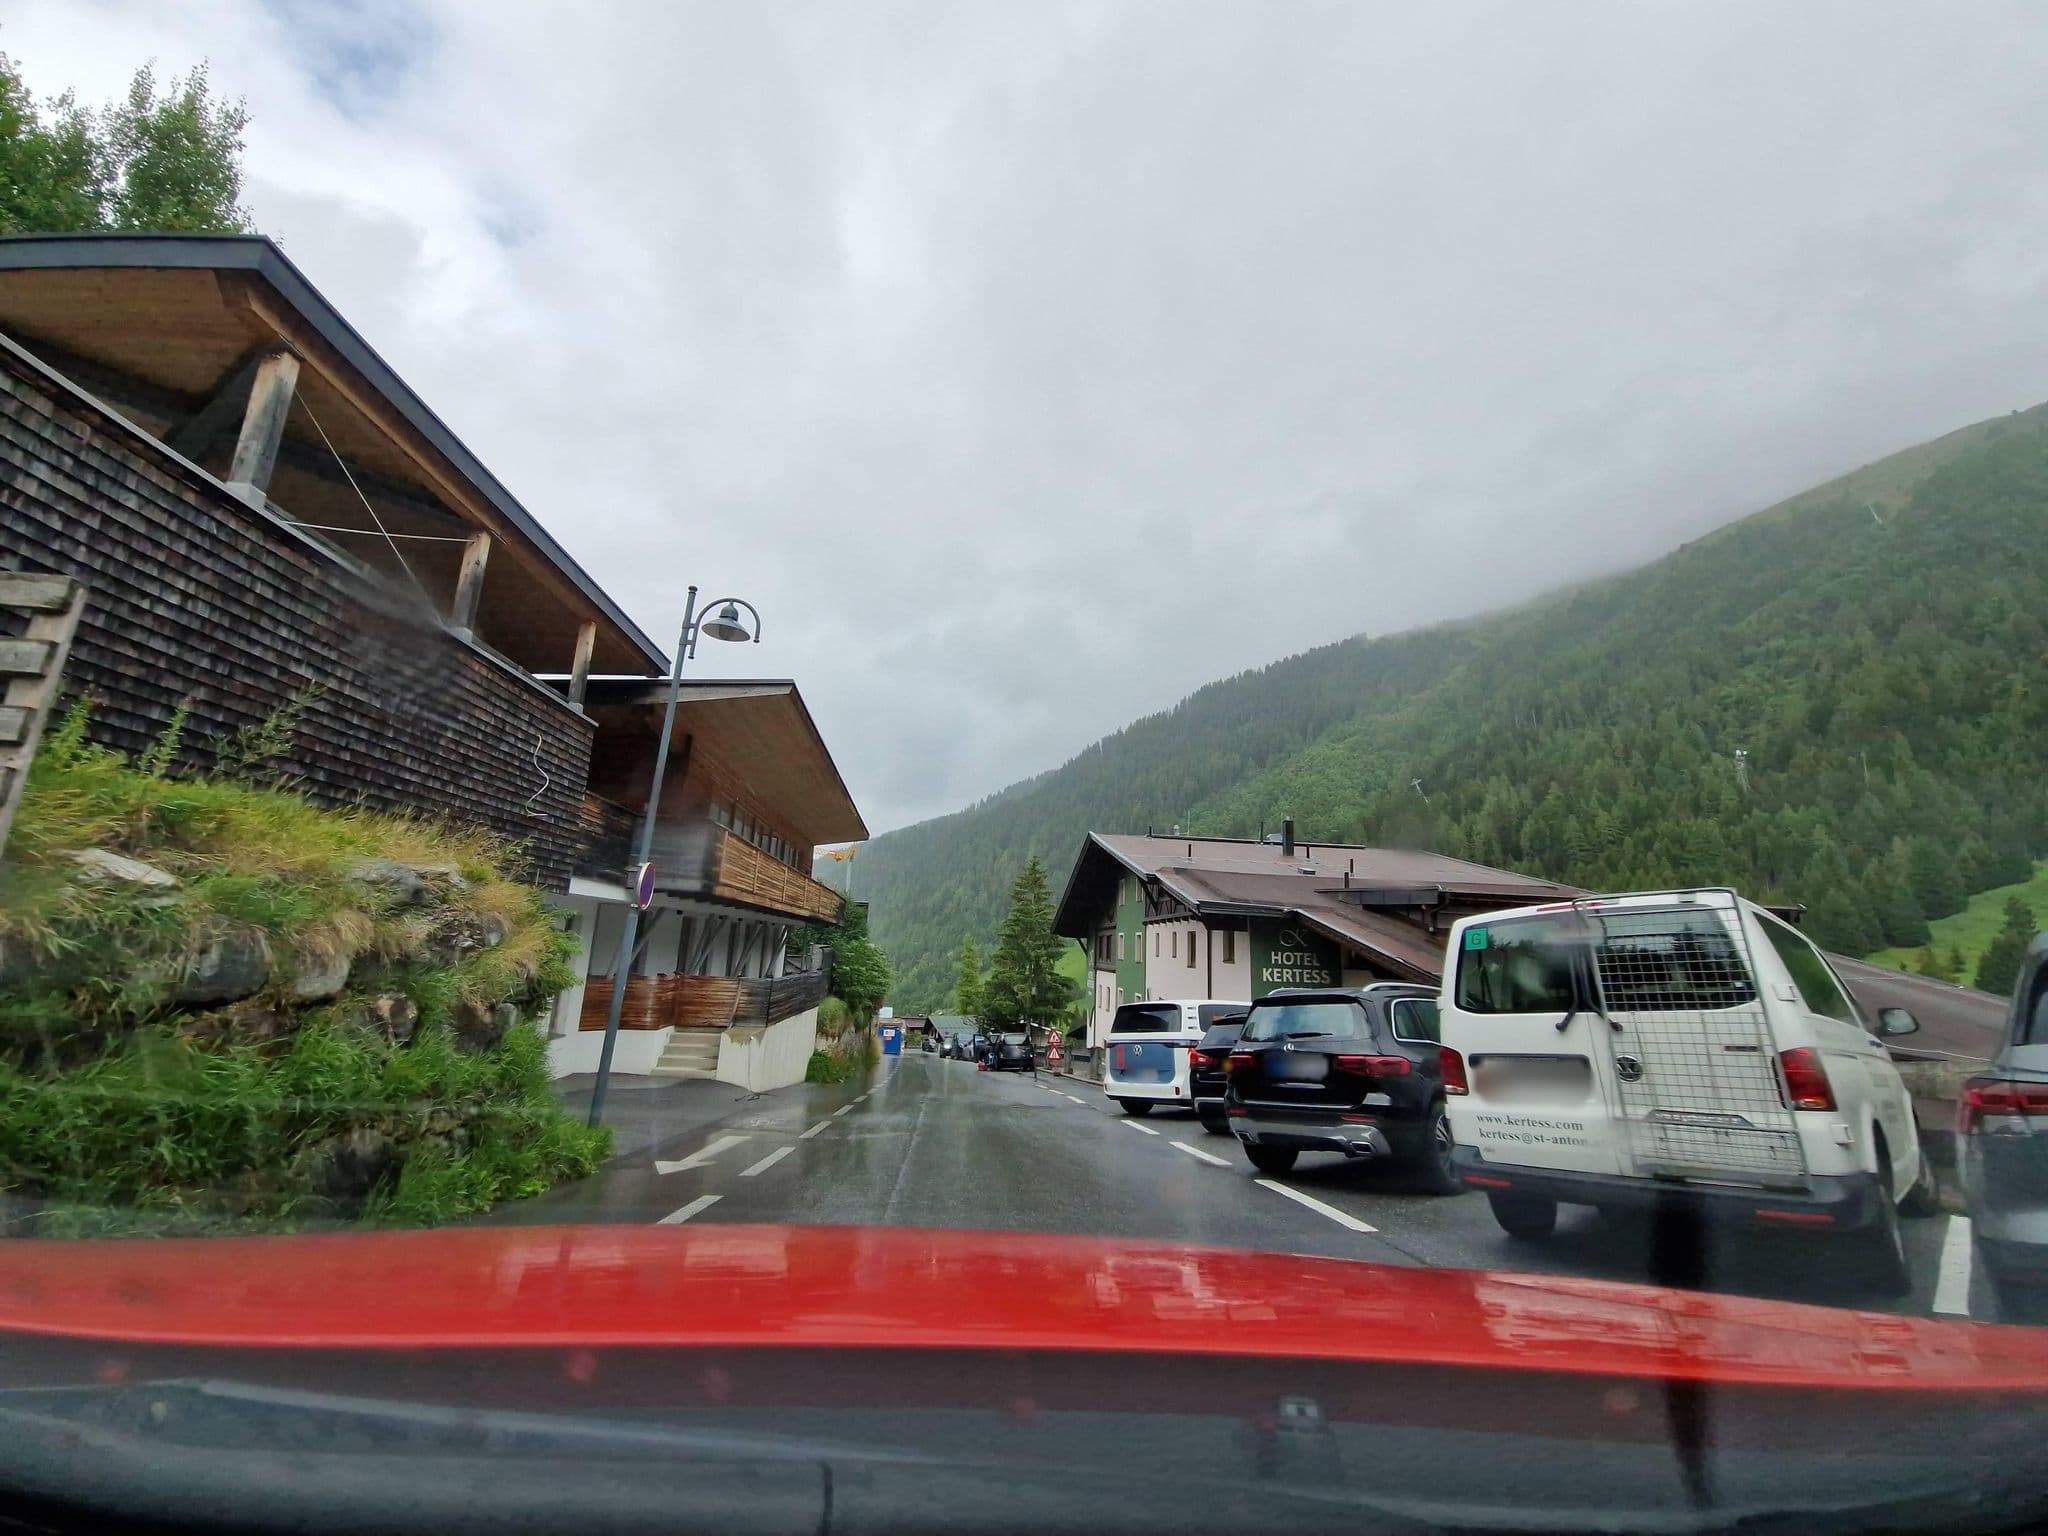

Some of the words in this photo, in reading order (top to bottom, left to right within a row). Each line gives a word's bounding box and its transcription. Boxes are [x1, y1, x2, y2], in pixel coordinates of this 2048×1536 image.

[1472, 933, 1481, 945] G
[1271, 951, 1320, 966] HOTEL
[1262, 968, 1331, 984] KERTESS
[1476, 1113, 1584, 1131] www.kertess.com
